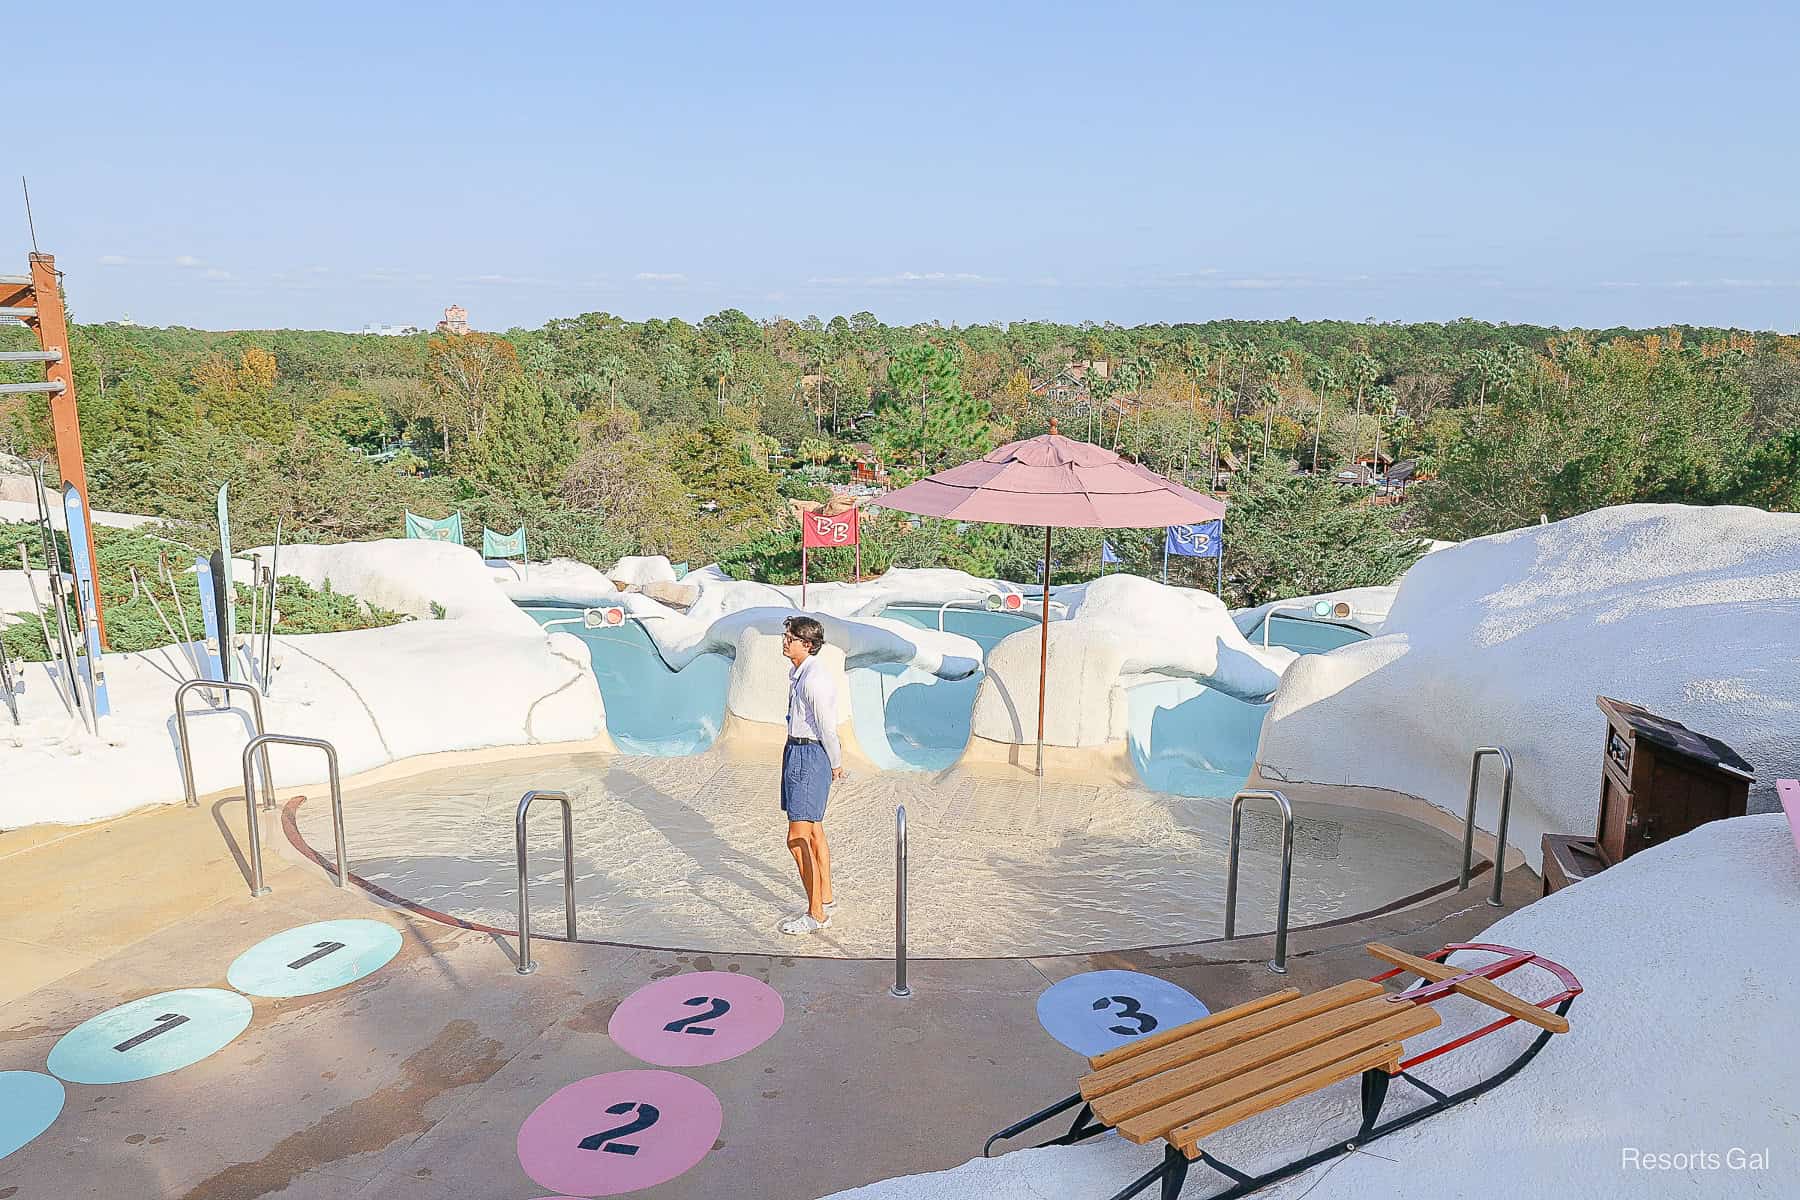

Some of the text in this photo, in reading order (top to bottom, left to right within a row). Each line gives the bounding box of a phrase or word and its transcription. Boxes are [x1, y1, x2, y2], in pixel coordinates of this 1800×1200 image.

[813, 516, 849, 543] BB
[1175, 525, 1210, 553] BB
[287, 941, 346, 969] 1
[113, 1013, 191, 1053] 1
[662, 996, 731, 1035] 2
[1092, 995, 1158, 1035] 3
[577, 1102, 660, 1155] 2
